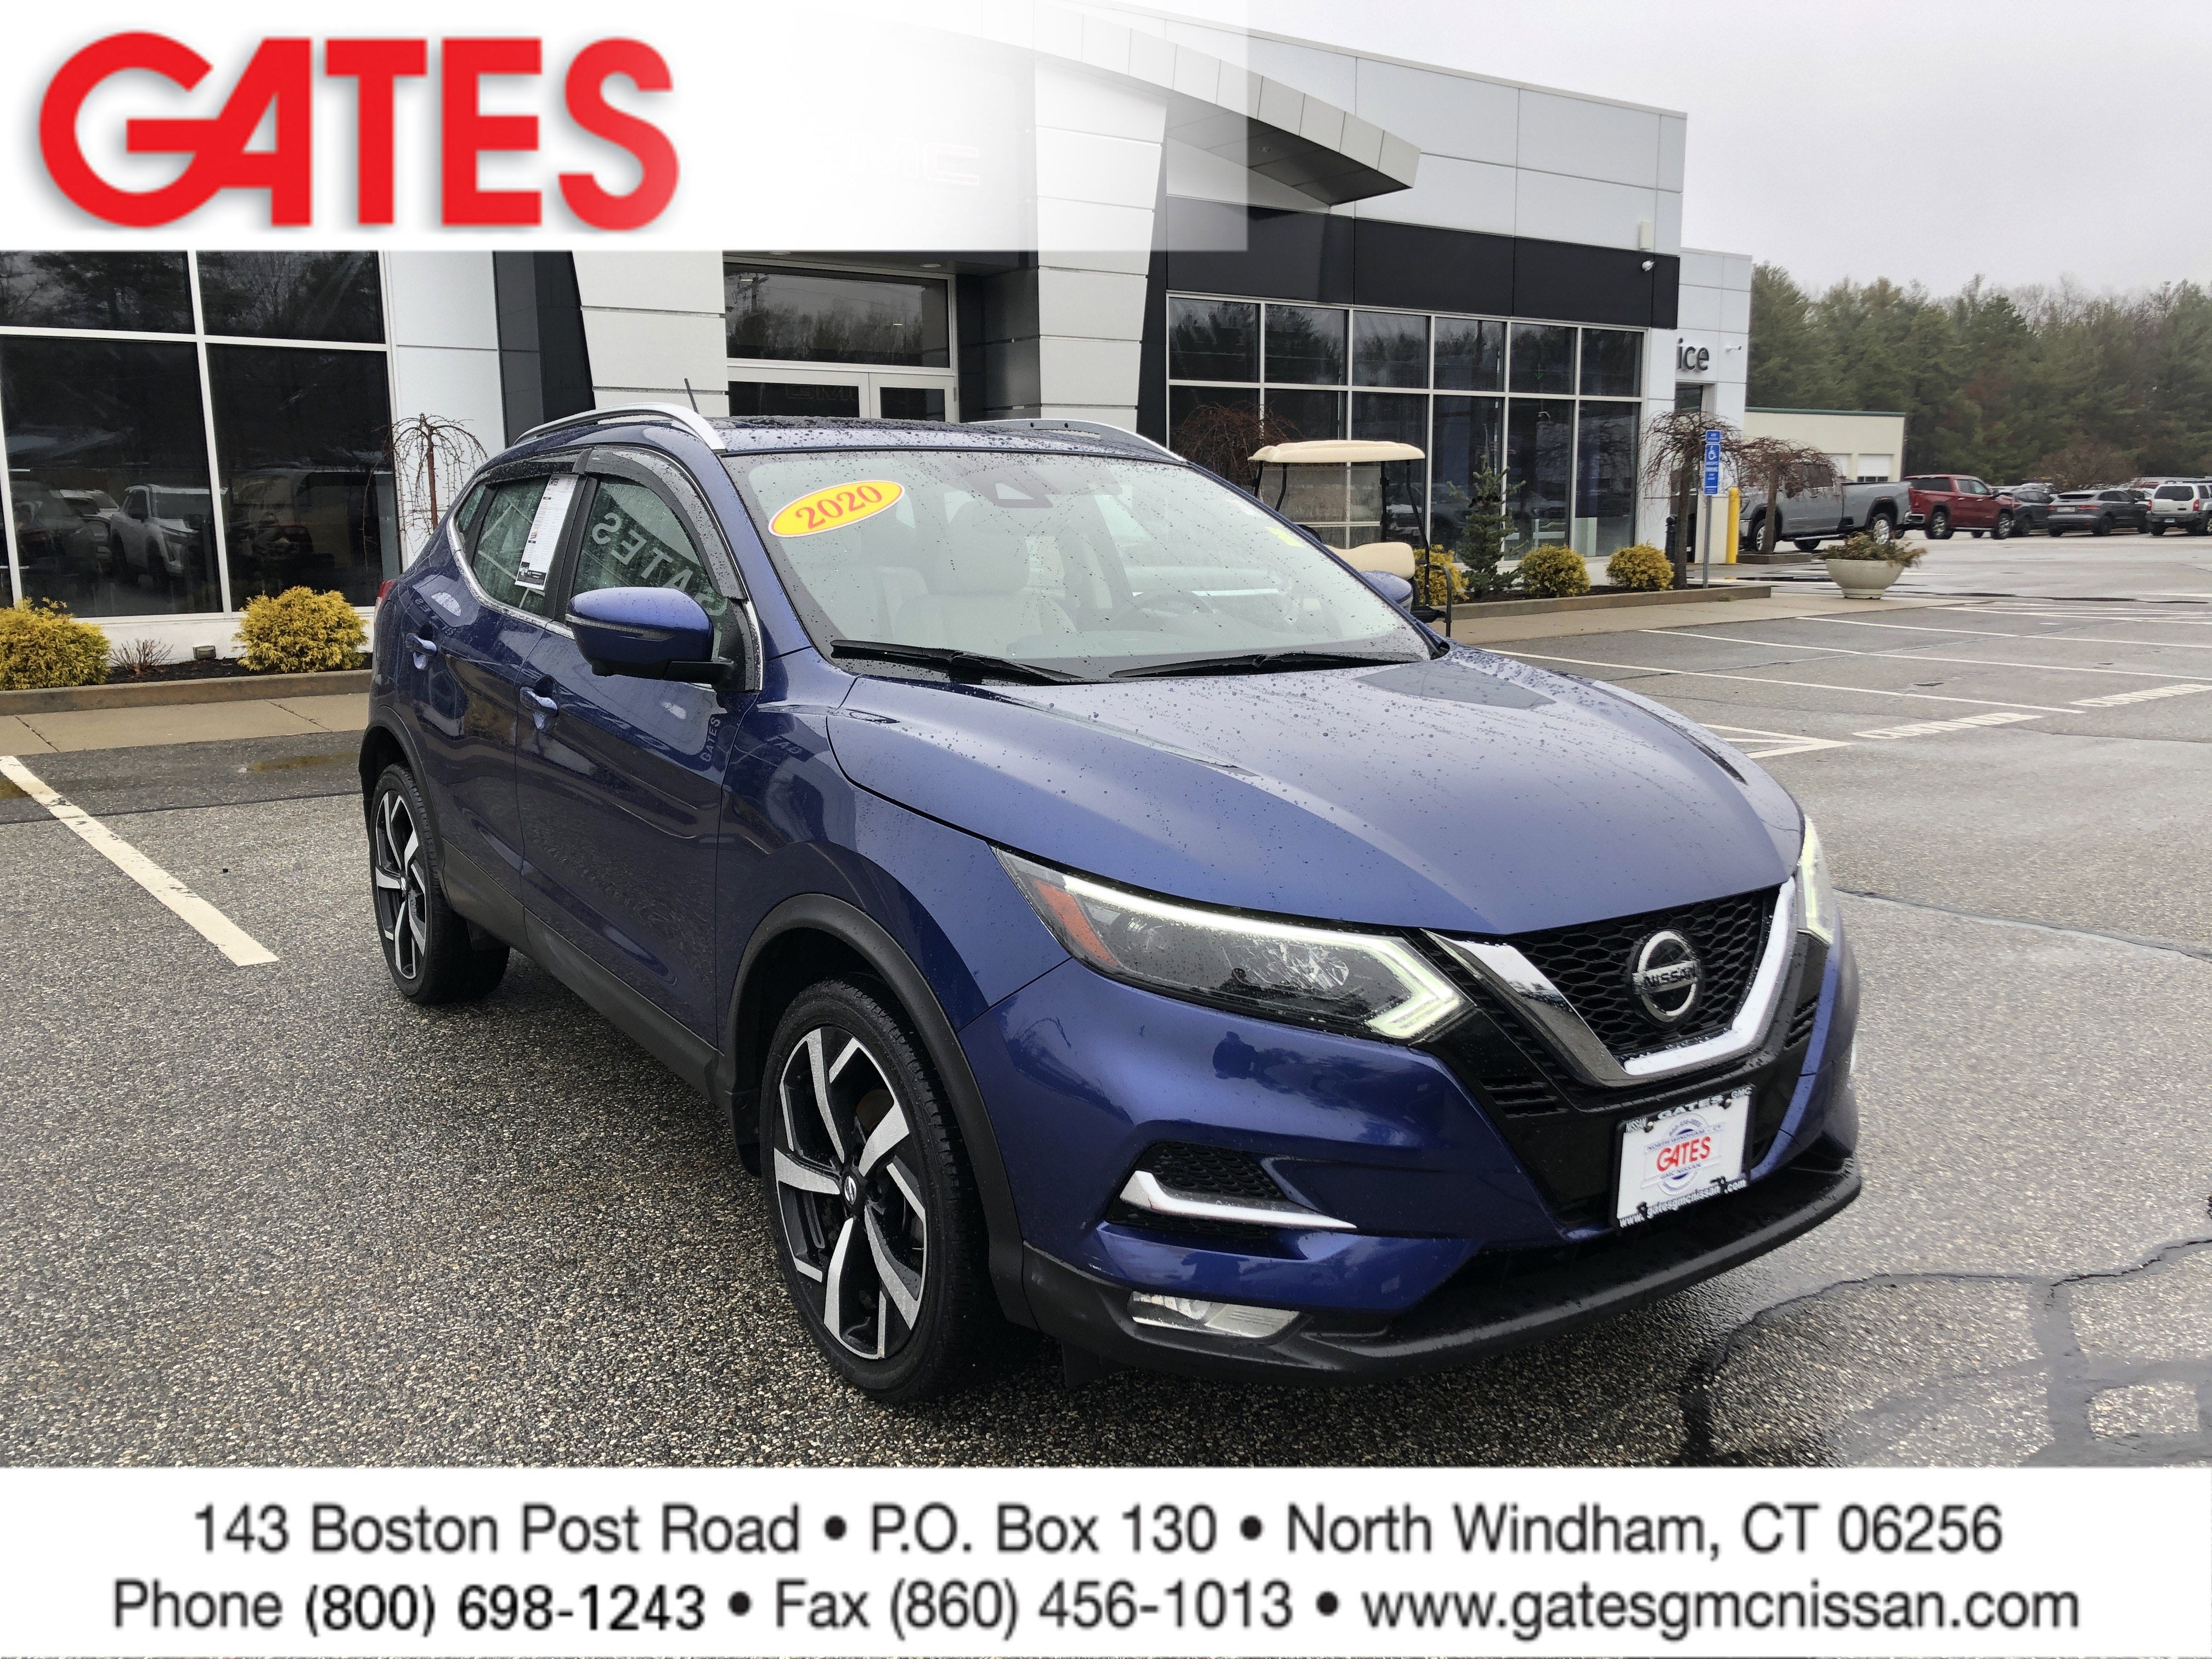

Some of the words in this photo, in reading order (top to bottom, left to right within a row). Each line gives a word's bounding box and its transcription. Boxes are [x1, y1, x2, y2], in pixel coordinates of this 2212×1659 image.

[795, 486, 882, 529] 2020
[1644, 967, 1696, 987] NISSAN
[1657, 1094, 1724, 1120] GATES
[1731, 1087, 1753, 1099] GMC
[1656, 1136, 1711, 1172] GATES
